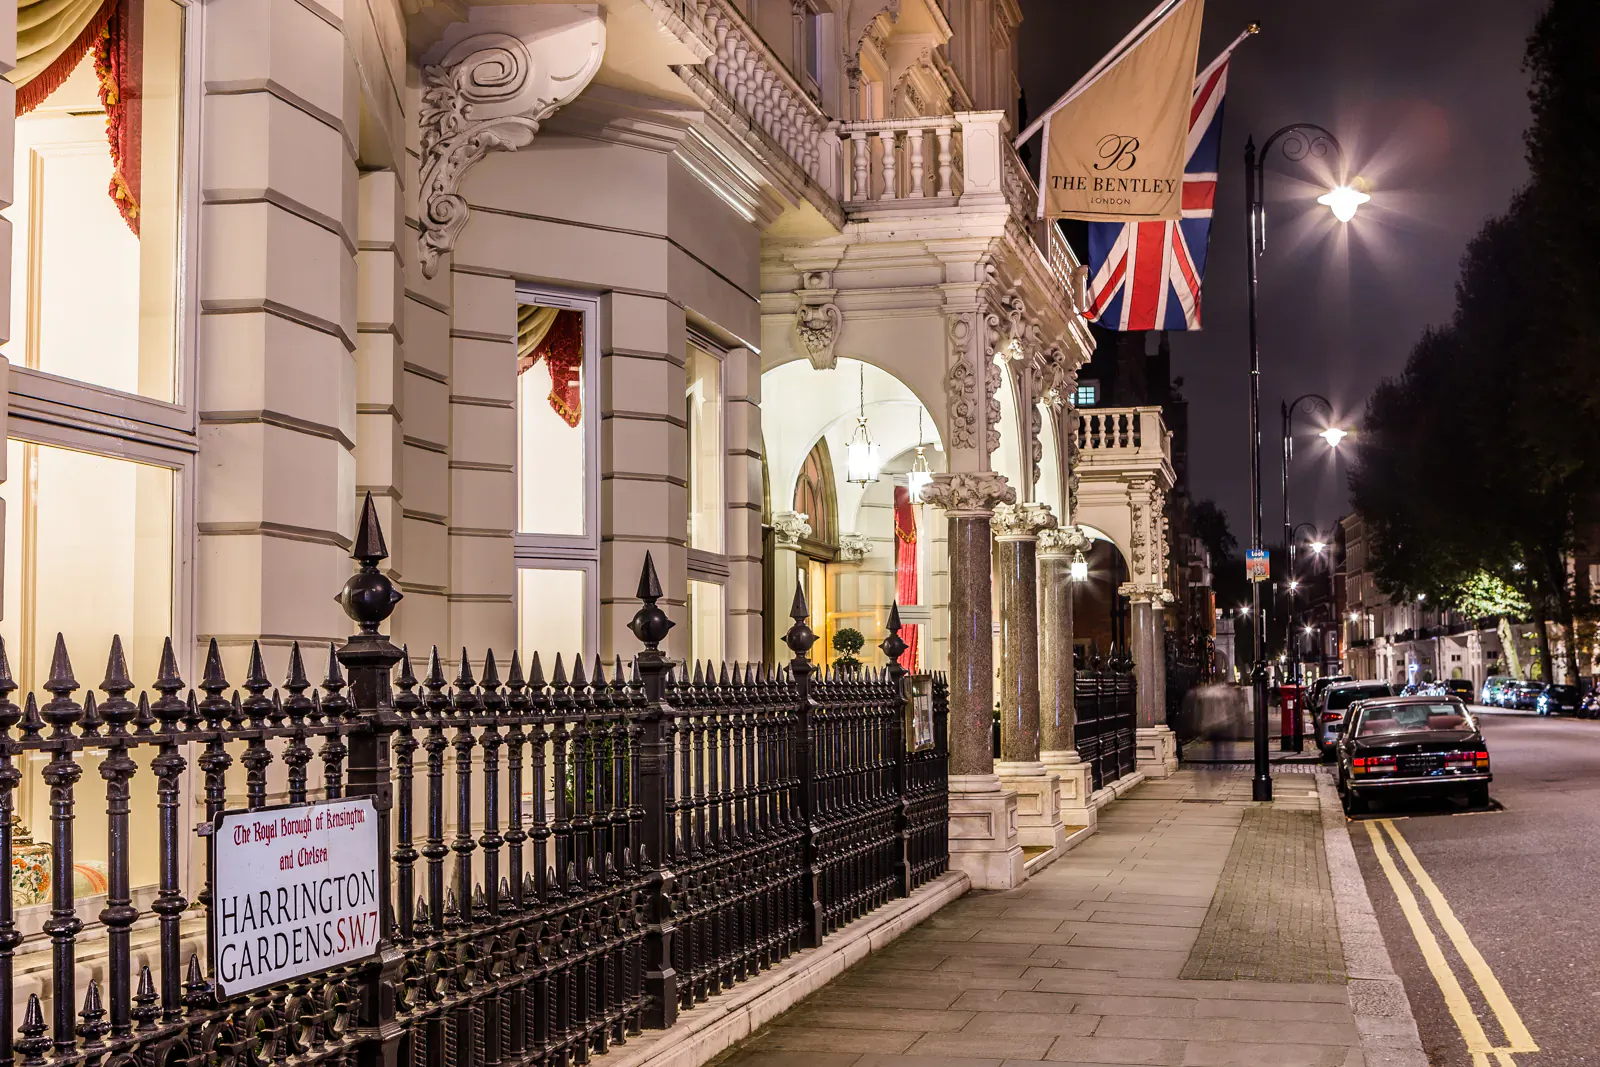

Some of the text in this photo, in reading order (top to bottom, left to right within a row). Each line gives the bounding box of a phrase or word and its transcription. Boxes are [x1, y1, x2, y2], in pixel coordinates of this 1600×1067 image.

[1093, 134, 1140, 171] B
[1052, 175, 1176, 194] THE BENTLEY
[1090, 197, 1131, 205] LONDON
[233, 807, 366, 846] The Royal Borough of Kensington
[279, 846, 329, 871] and Chelsea
[221, 869, 376, 937] HARRINGTON
